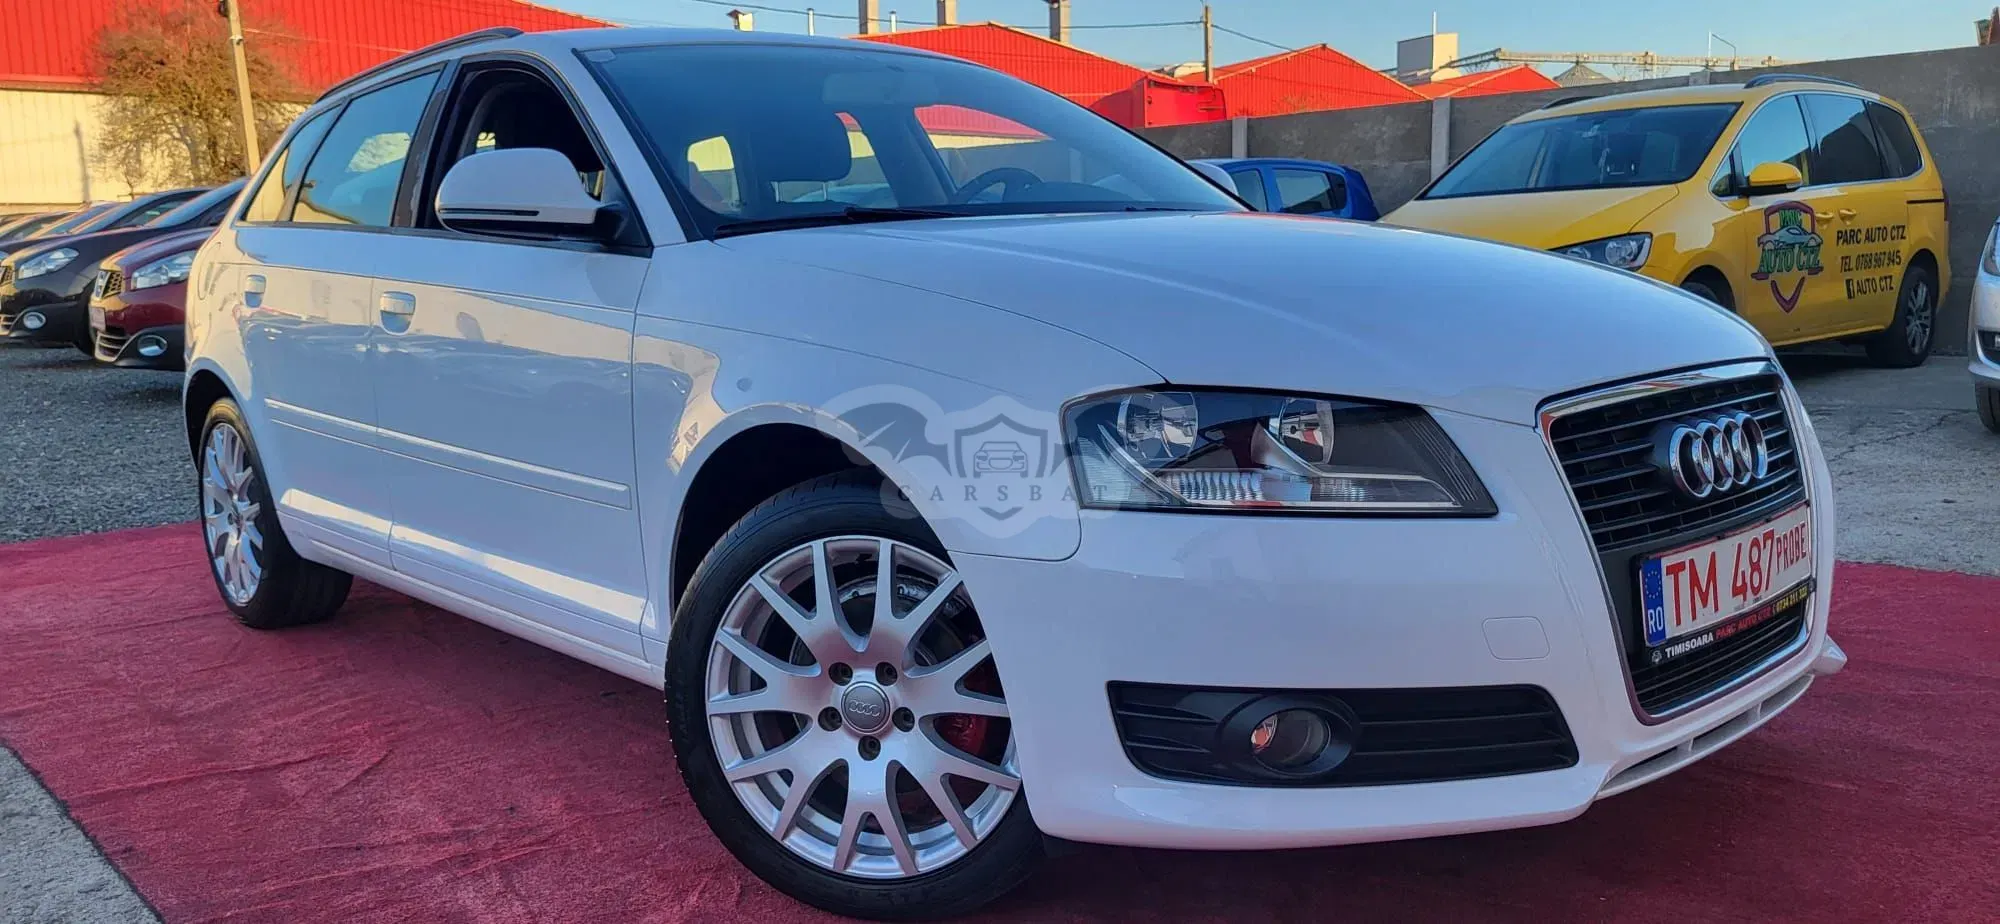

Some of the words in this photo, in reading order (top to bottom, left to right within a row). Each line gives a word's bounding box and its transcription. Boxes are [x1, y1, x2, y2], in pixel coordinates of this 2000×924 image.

[1836, 229, 1862, 247] PARC
[1864, 226, 1887, 244] AUTO
[1890, 224, 1907, 241] CTZ
[1760, 247, 1794, 273] AUTO
[1796, 246, 1821, 271] CTZ
[1856, 277, 1878, 295] AUTO
[1879, 275, 1894, 292] CTZ
[1666, 551, 1719, 626] TM
[1731, 528, 1774, 602] 487
[1776, 522, 1807, 574] PROBE
[1648, 606, 1664, 634] RO
[1665, 632, 1714, 658] TIMISOARA
